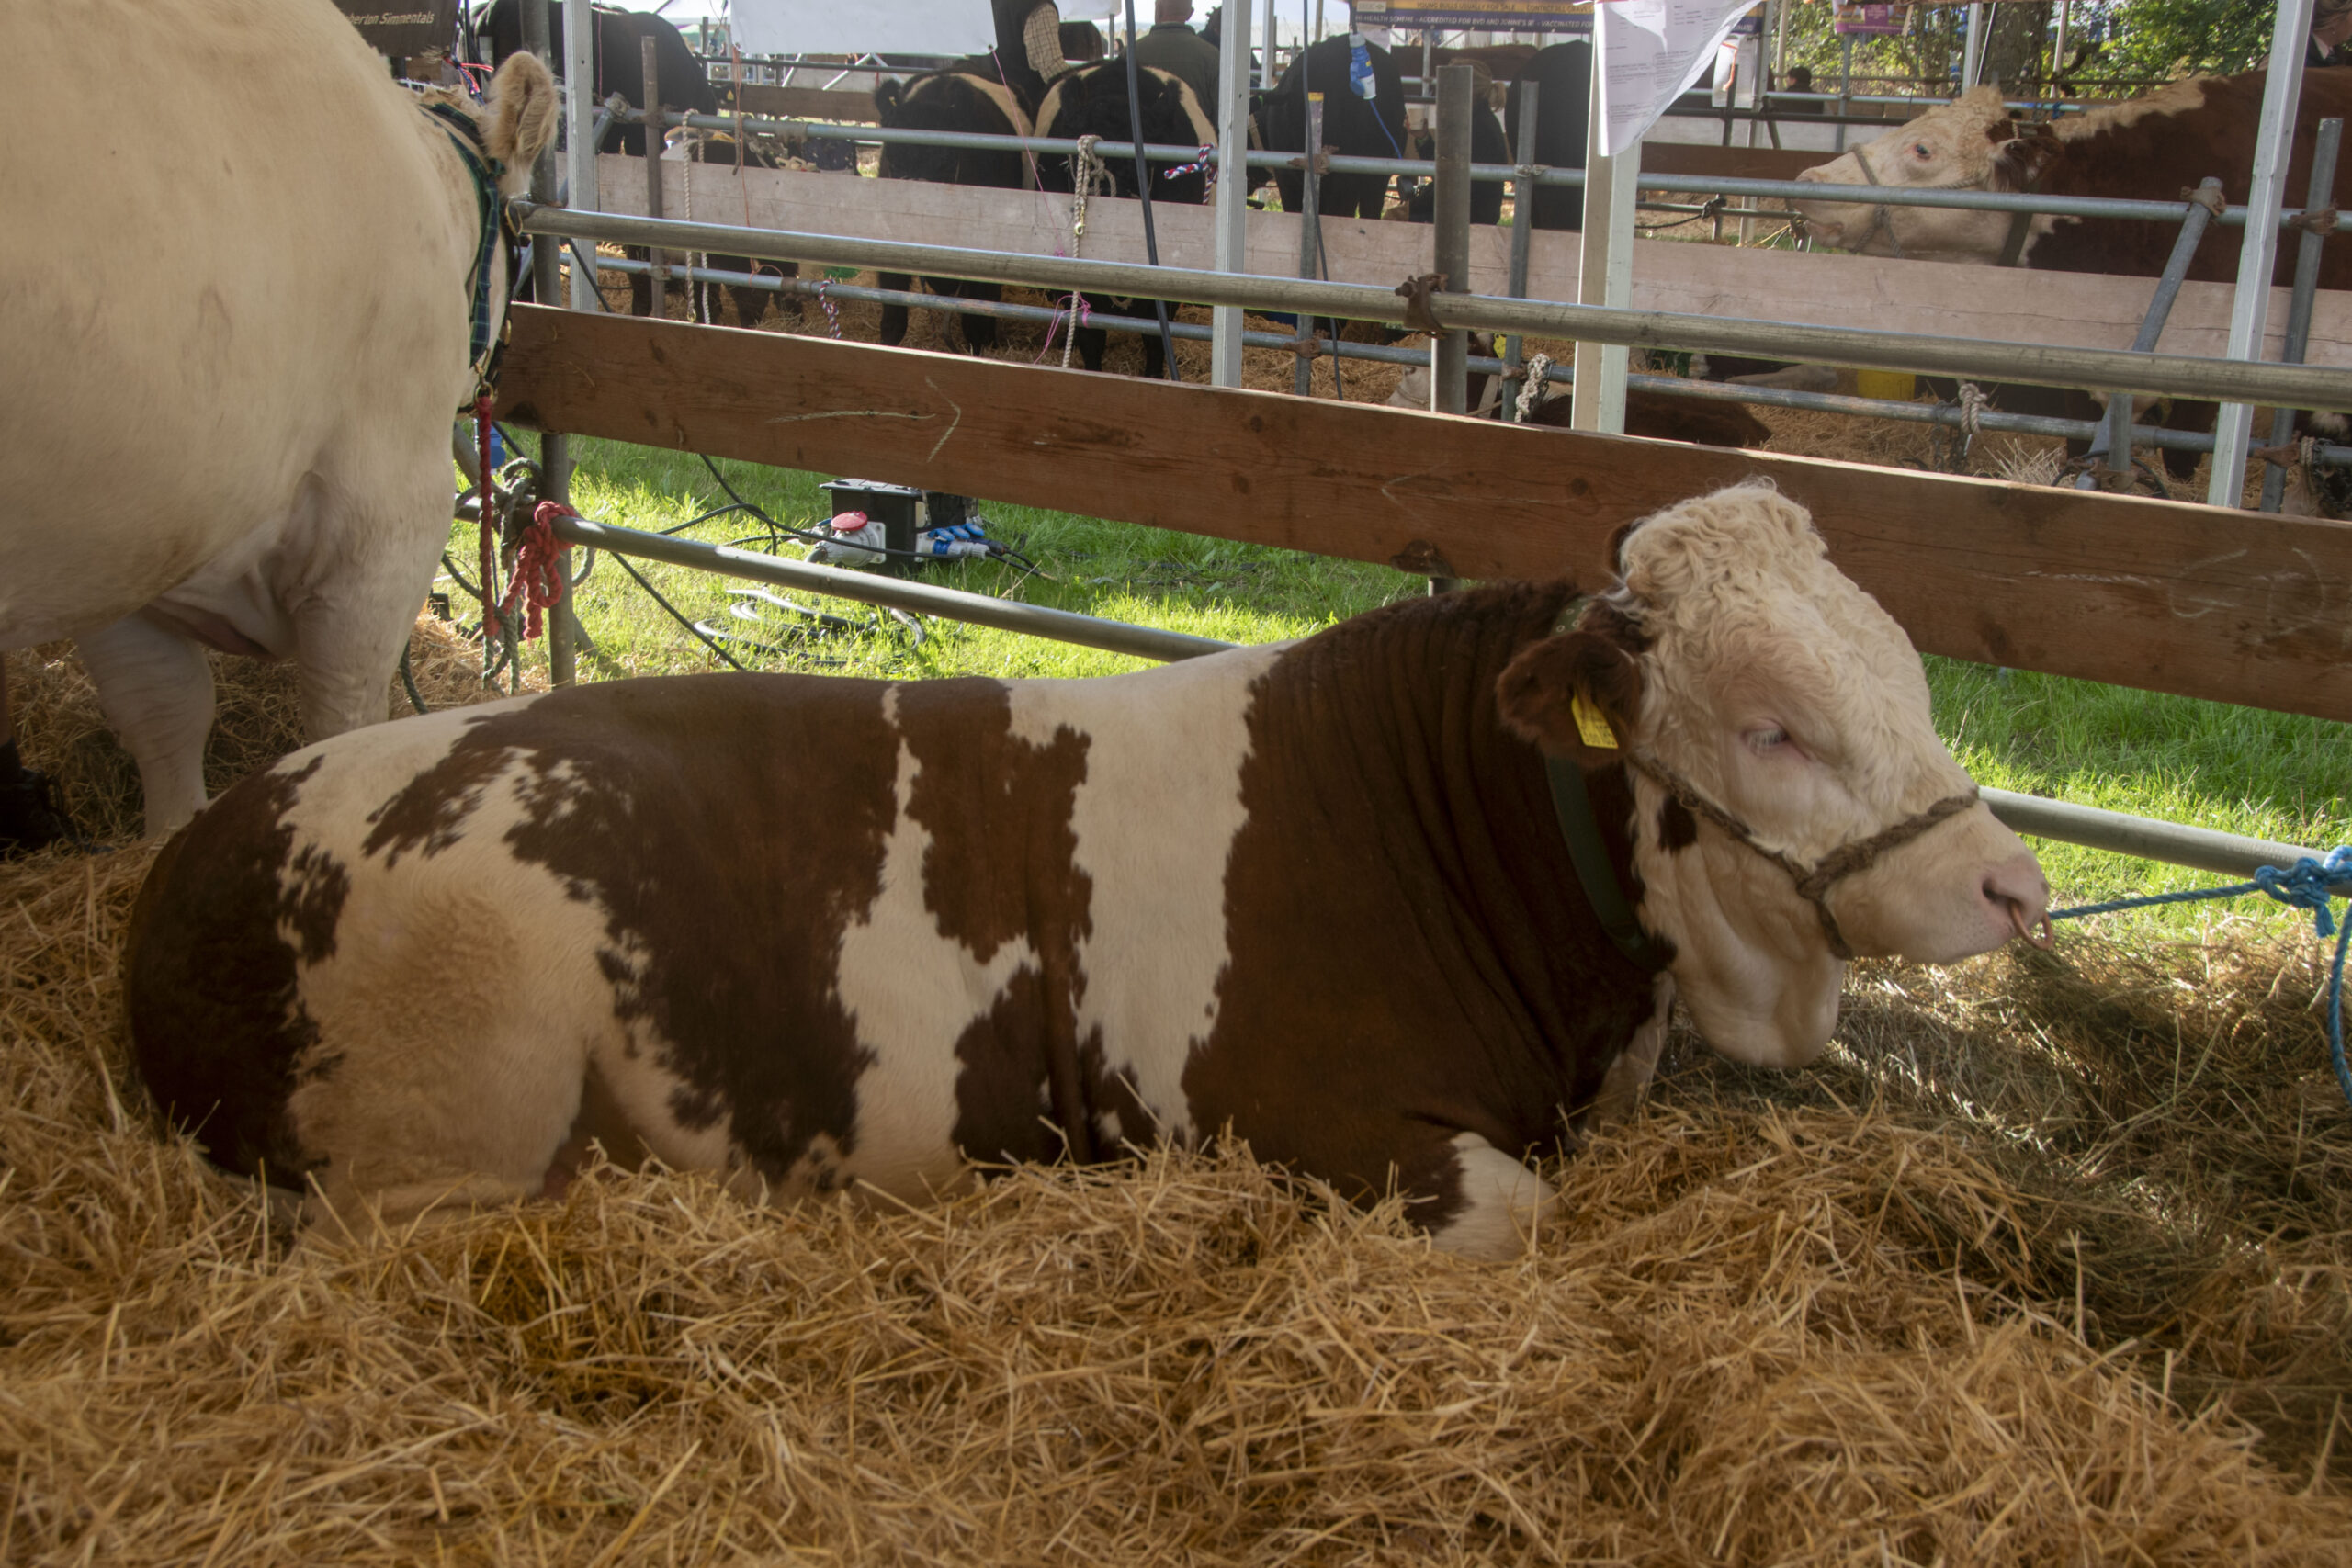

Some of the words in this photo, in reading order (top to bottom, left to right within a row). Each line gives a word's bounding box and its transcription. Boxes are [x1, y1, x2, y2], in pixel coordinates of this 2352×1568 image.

[345, 12, 379, 25] berton
[379, 10, 435, 25] Simmentals
[1364, 15, 1388, 23] HEALTH
[1419, 16, 1457, 25] ACCREDITED
[1458, 17, 1471, 25] FOR
[1486, 17, 1499, 26] AND
[1541, 20, 1580, 28] VACCINATED
